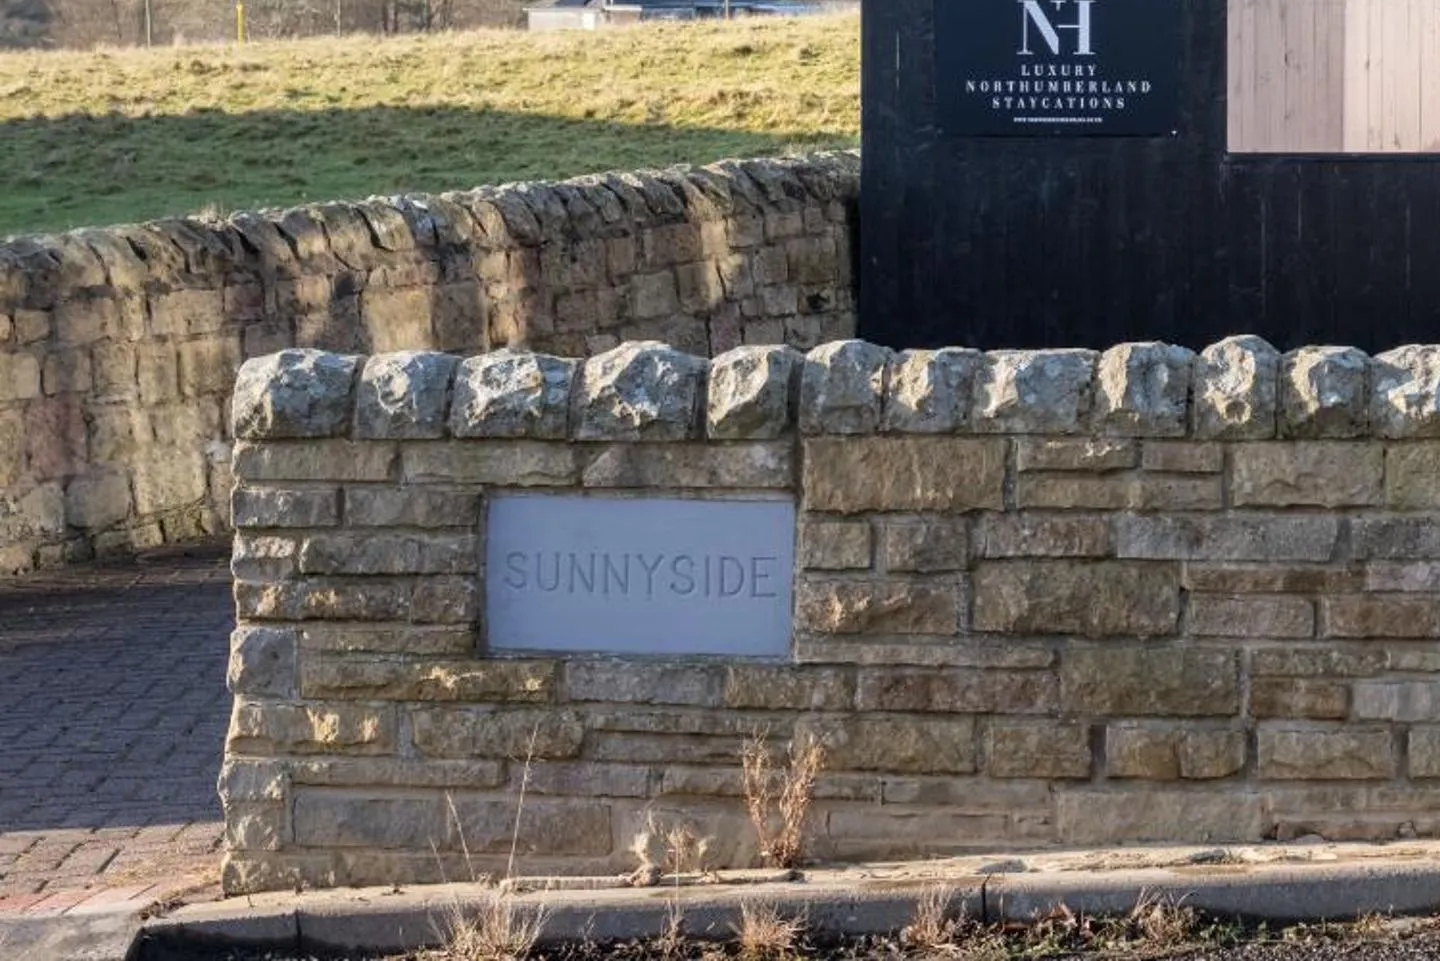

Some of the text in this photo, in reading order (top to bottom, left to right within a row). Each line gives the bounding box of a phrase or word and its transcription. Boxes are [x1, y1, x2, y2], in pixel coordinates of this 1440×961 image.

[1021, 64, 1098, 77] LUXURY
[965, 80, 1152, 93] NORTHUMBERLAND
[992, 96, 1126, 109] STAYCATIONS
[503, 550, 779, 599] SUNNYSIDE
